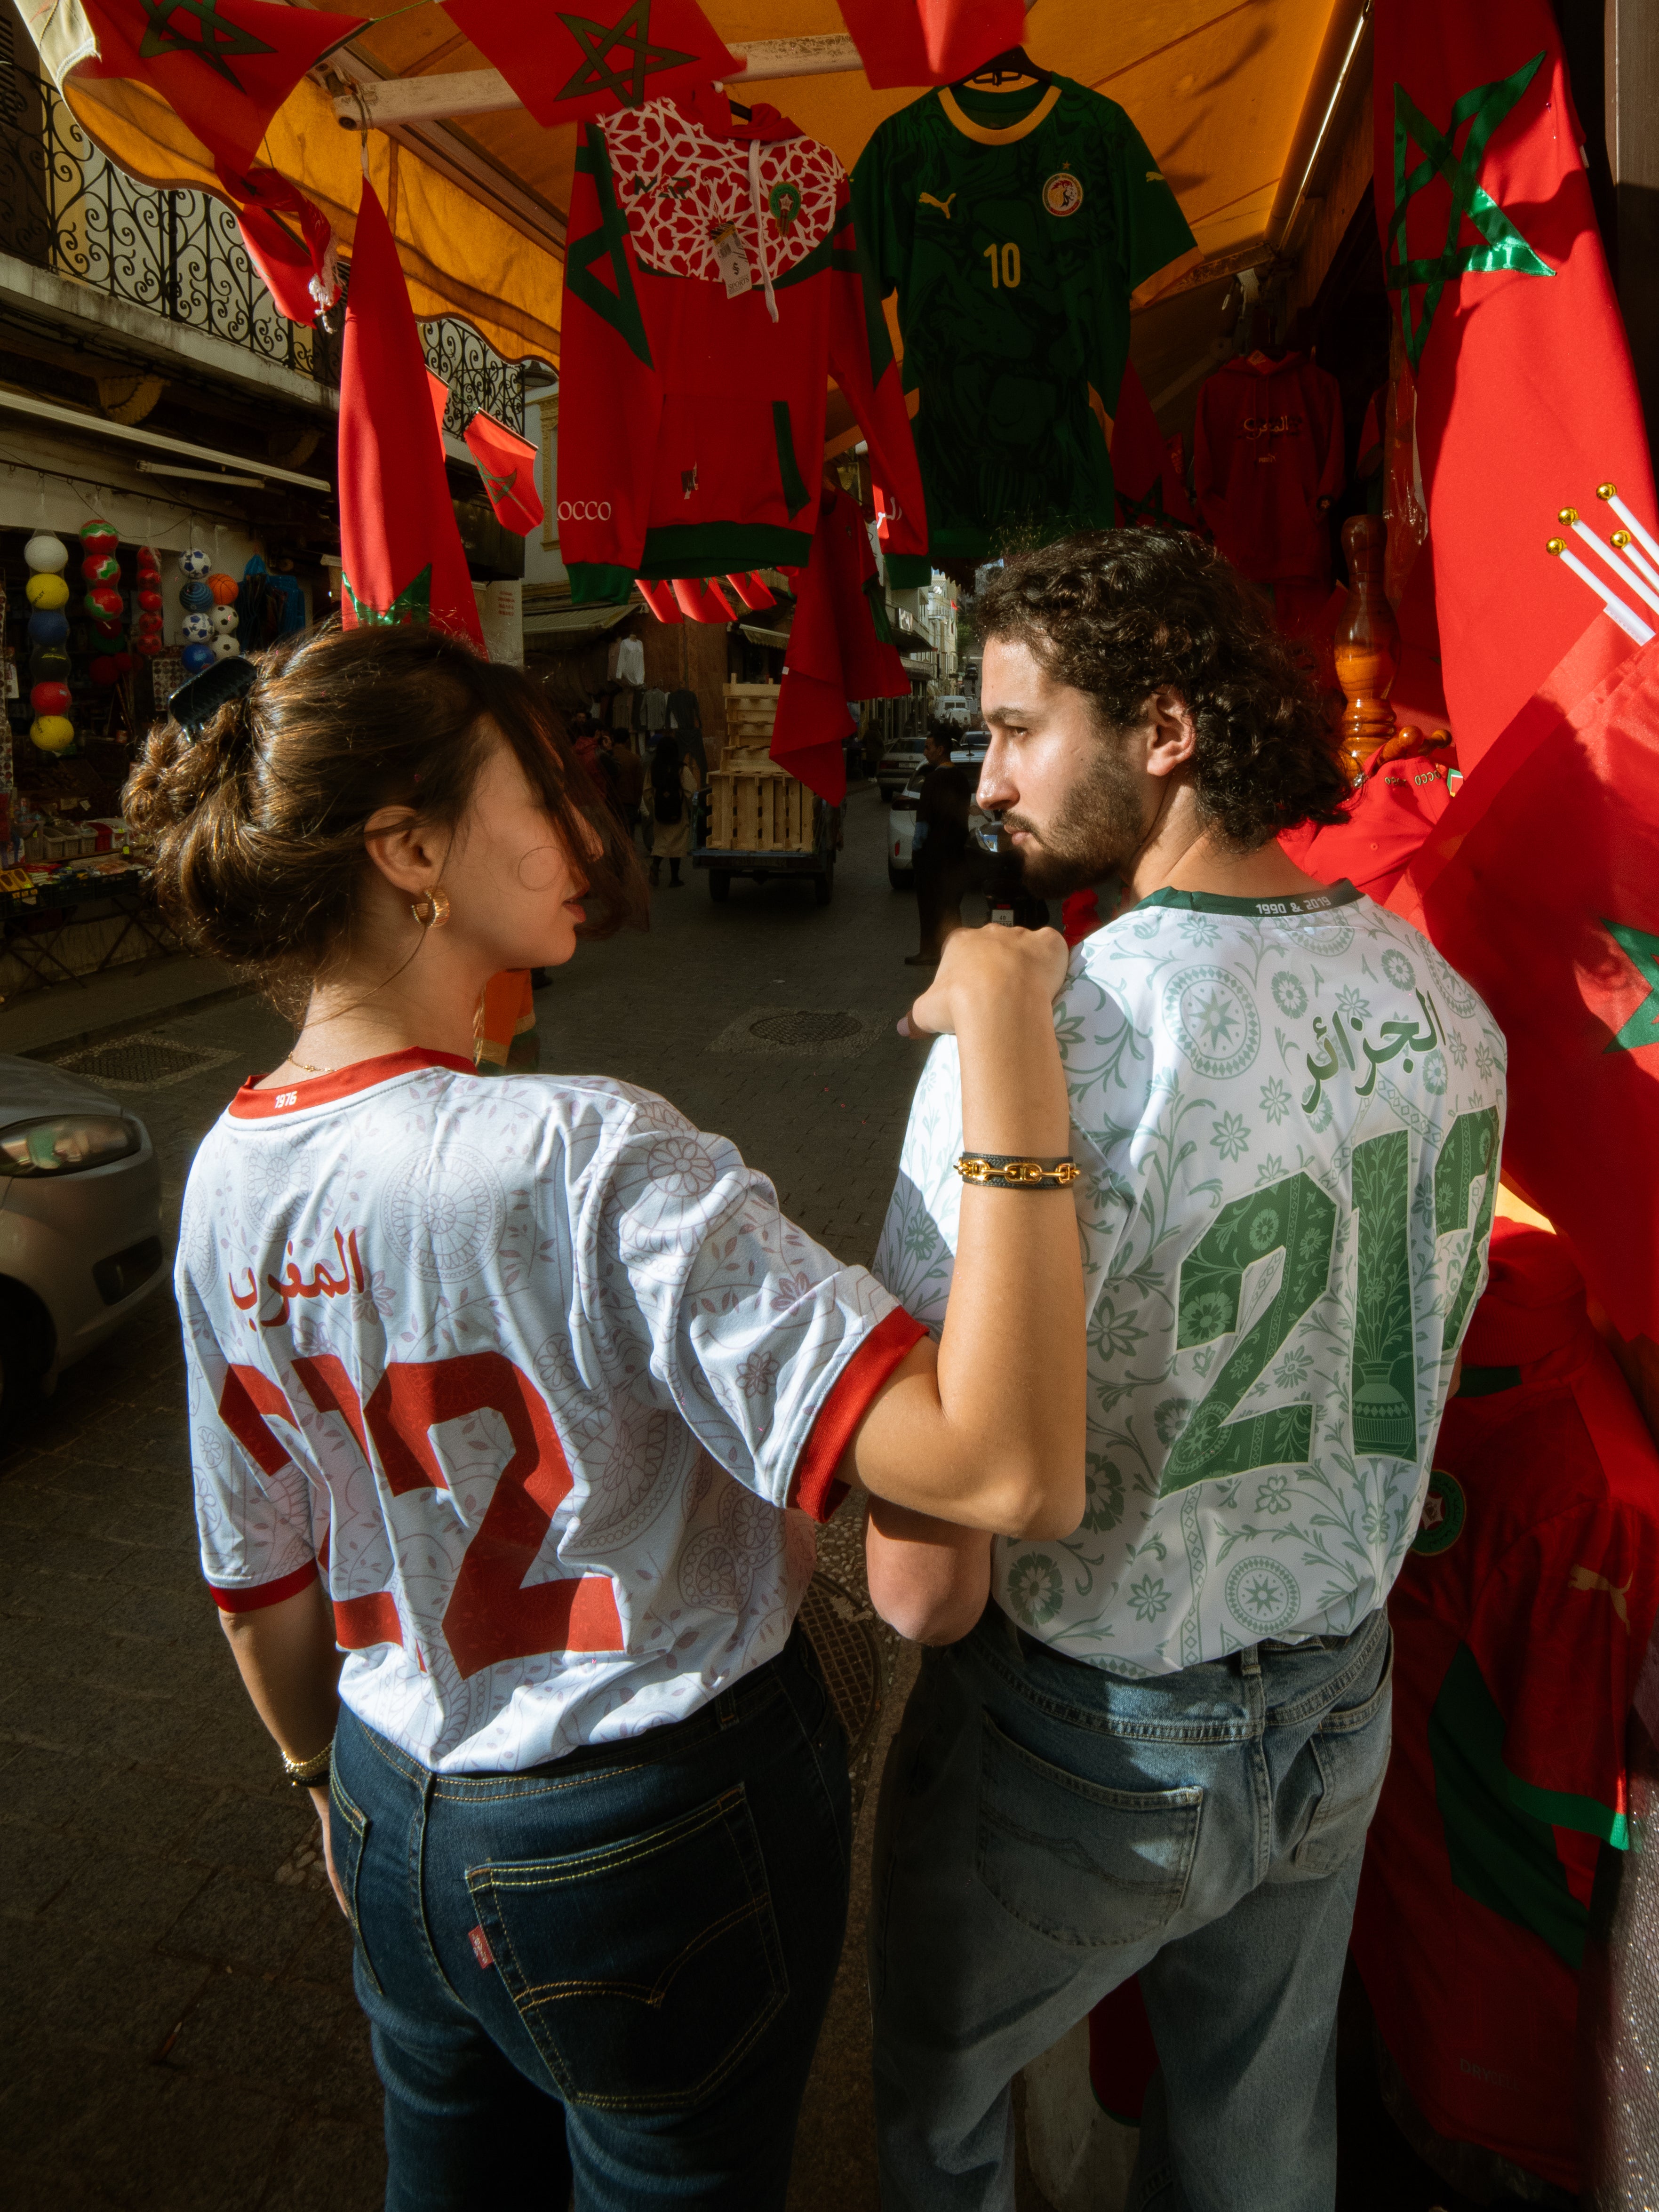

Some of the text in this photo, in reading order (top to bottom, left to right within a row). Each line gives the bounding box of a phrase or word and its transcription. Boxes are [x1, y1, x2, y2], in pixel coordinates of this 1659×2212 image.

[983, 242, 1021, 288] 10
[728, 275, 750, 291] SPORTS
[557, 501, 612, 521] OCCO
[1256, 896, 1331, 915] 1990 & 2019
[1301, 987, 1447, 1115] الجزائر
[274, 1091, 297, 1109] 1976
[229, 1226, 365, 1332] المغرب
[1460, 2058, 1520, 2092] DRYCELL
